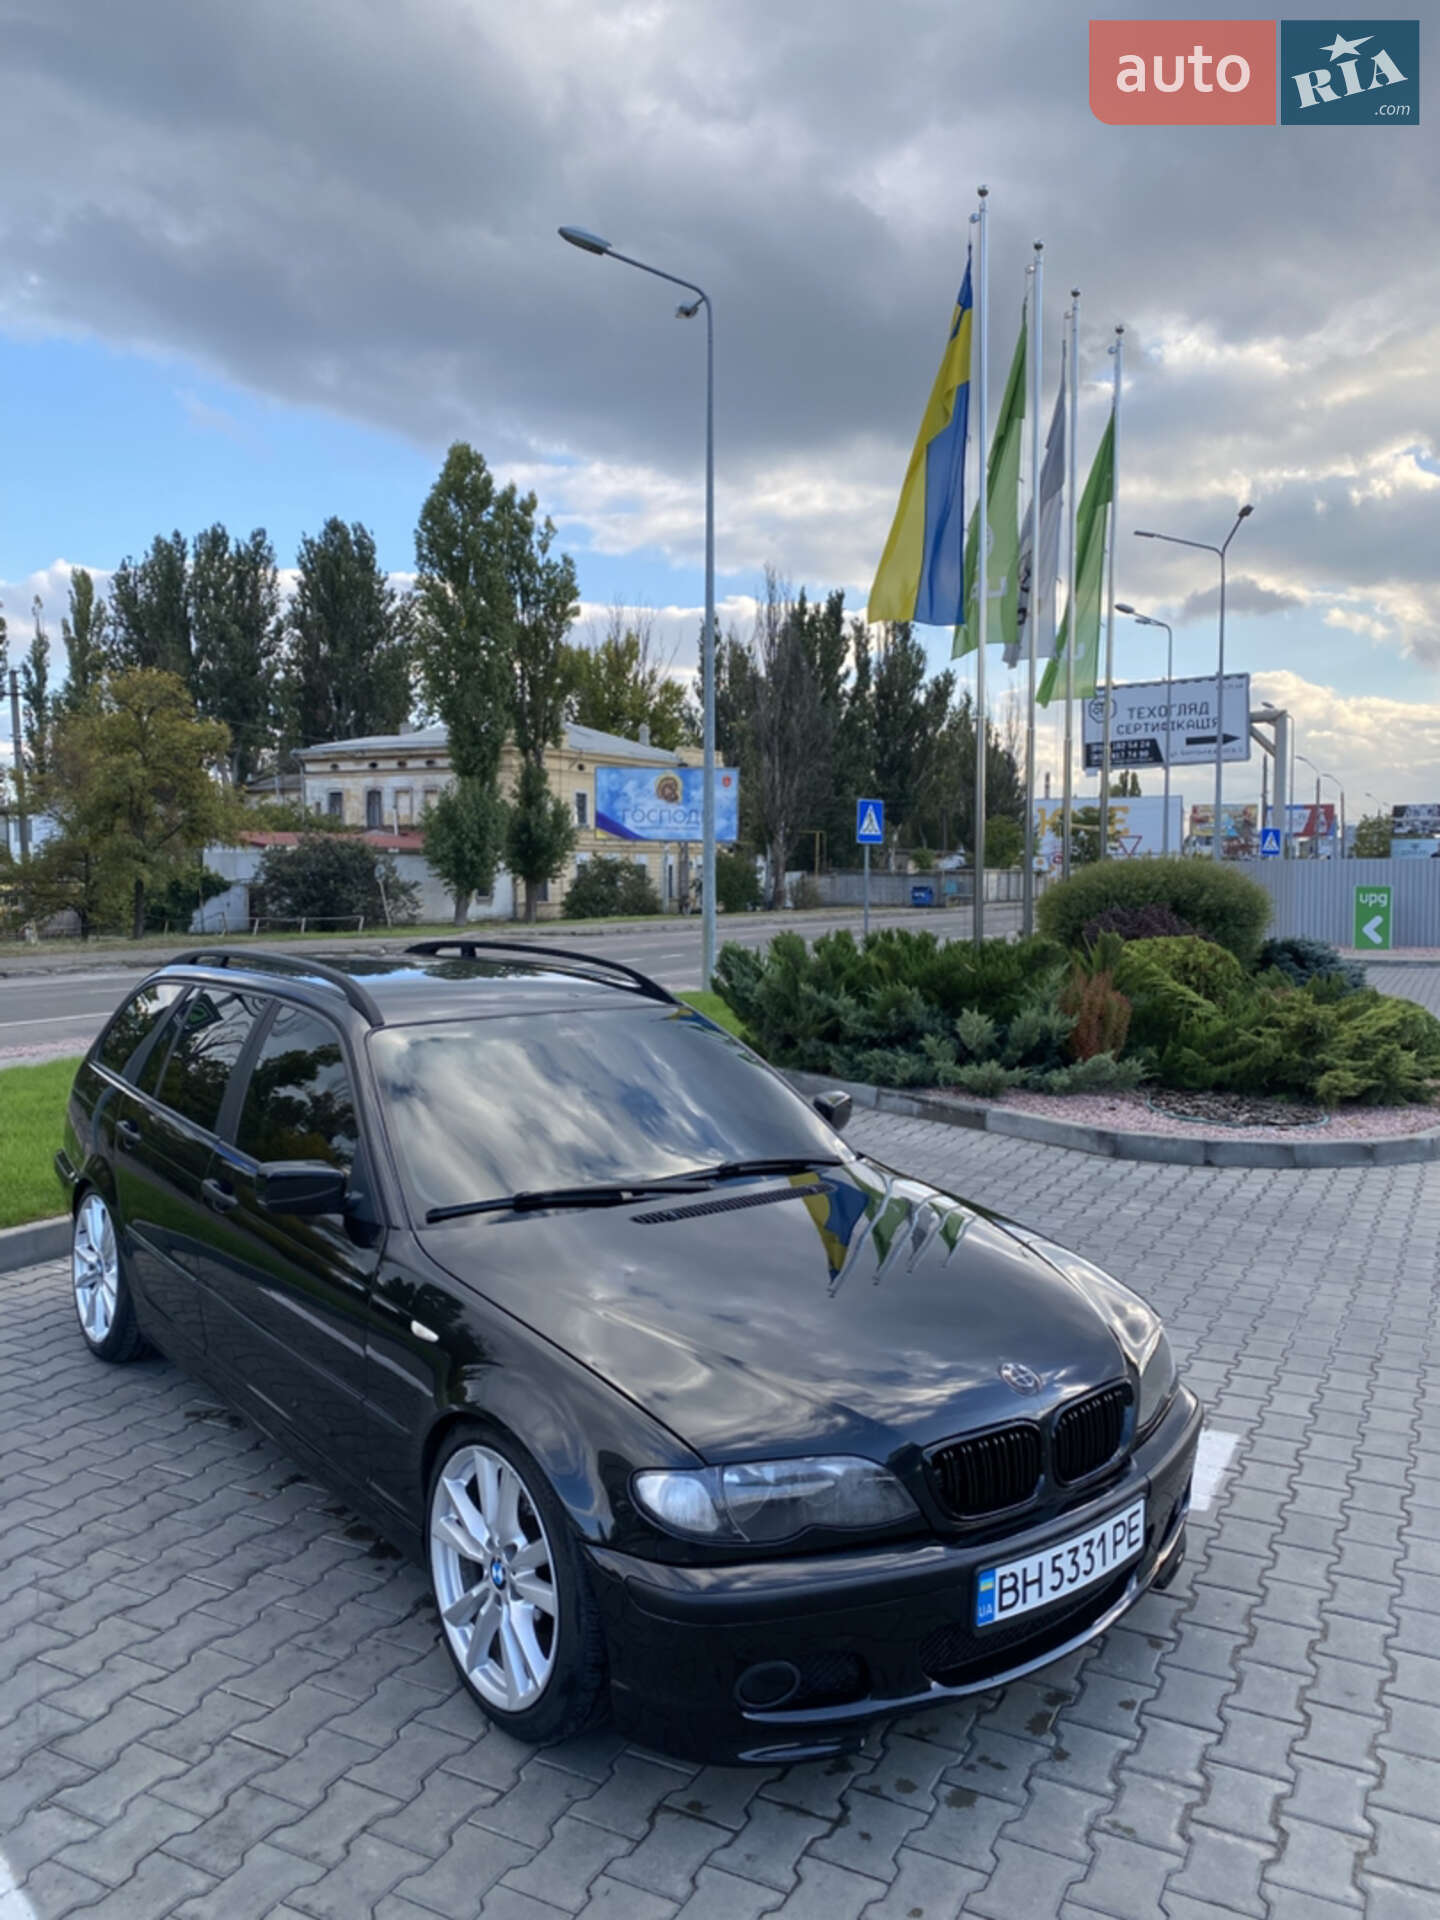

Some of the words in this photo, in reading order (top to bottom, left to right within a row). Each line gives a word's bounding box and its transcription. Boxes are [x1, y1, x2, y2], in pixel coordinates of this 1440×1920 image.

[1359, 893, 1388, 908] upg
[998, 1561, 1043, 1613] BH
[1050, 1532, 1107, 1592] 5331
[1112, 1509, 1142, 1560] PE
[978, 1603, 993, 1617] UA
